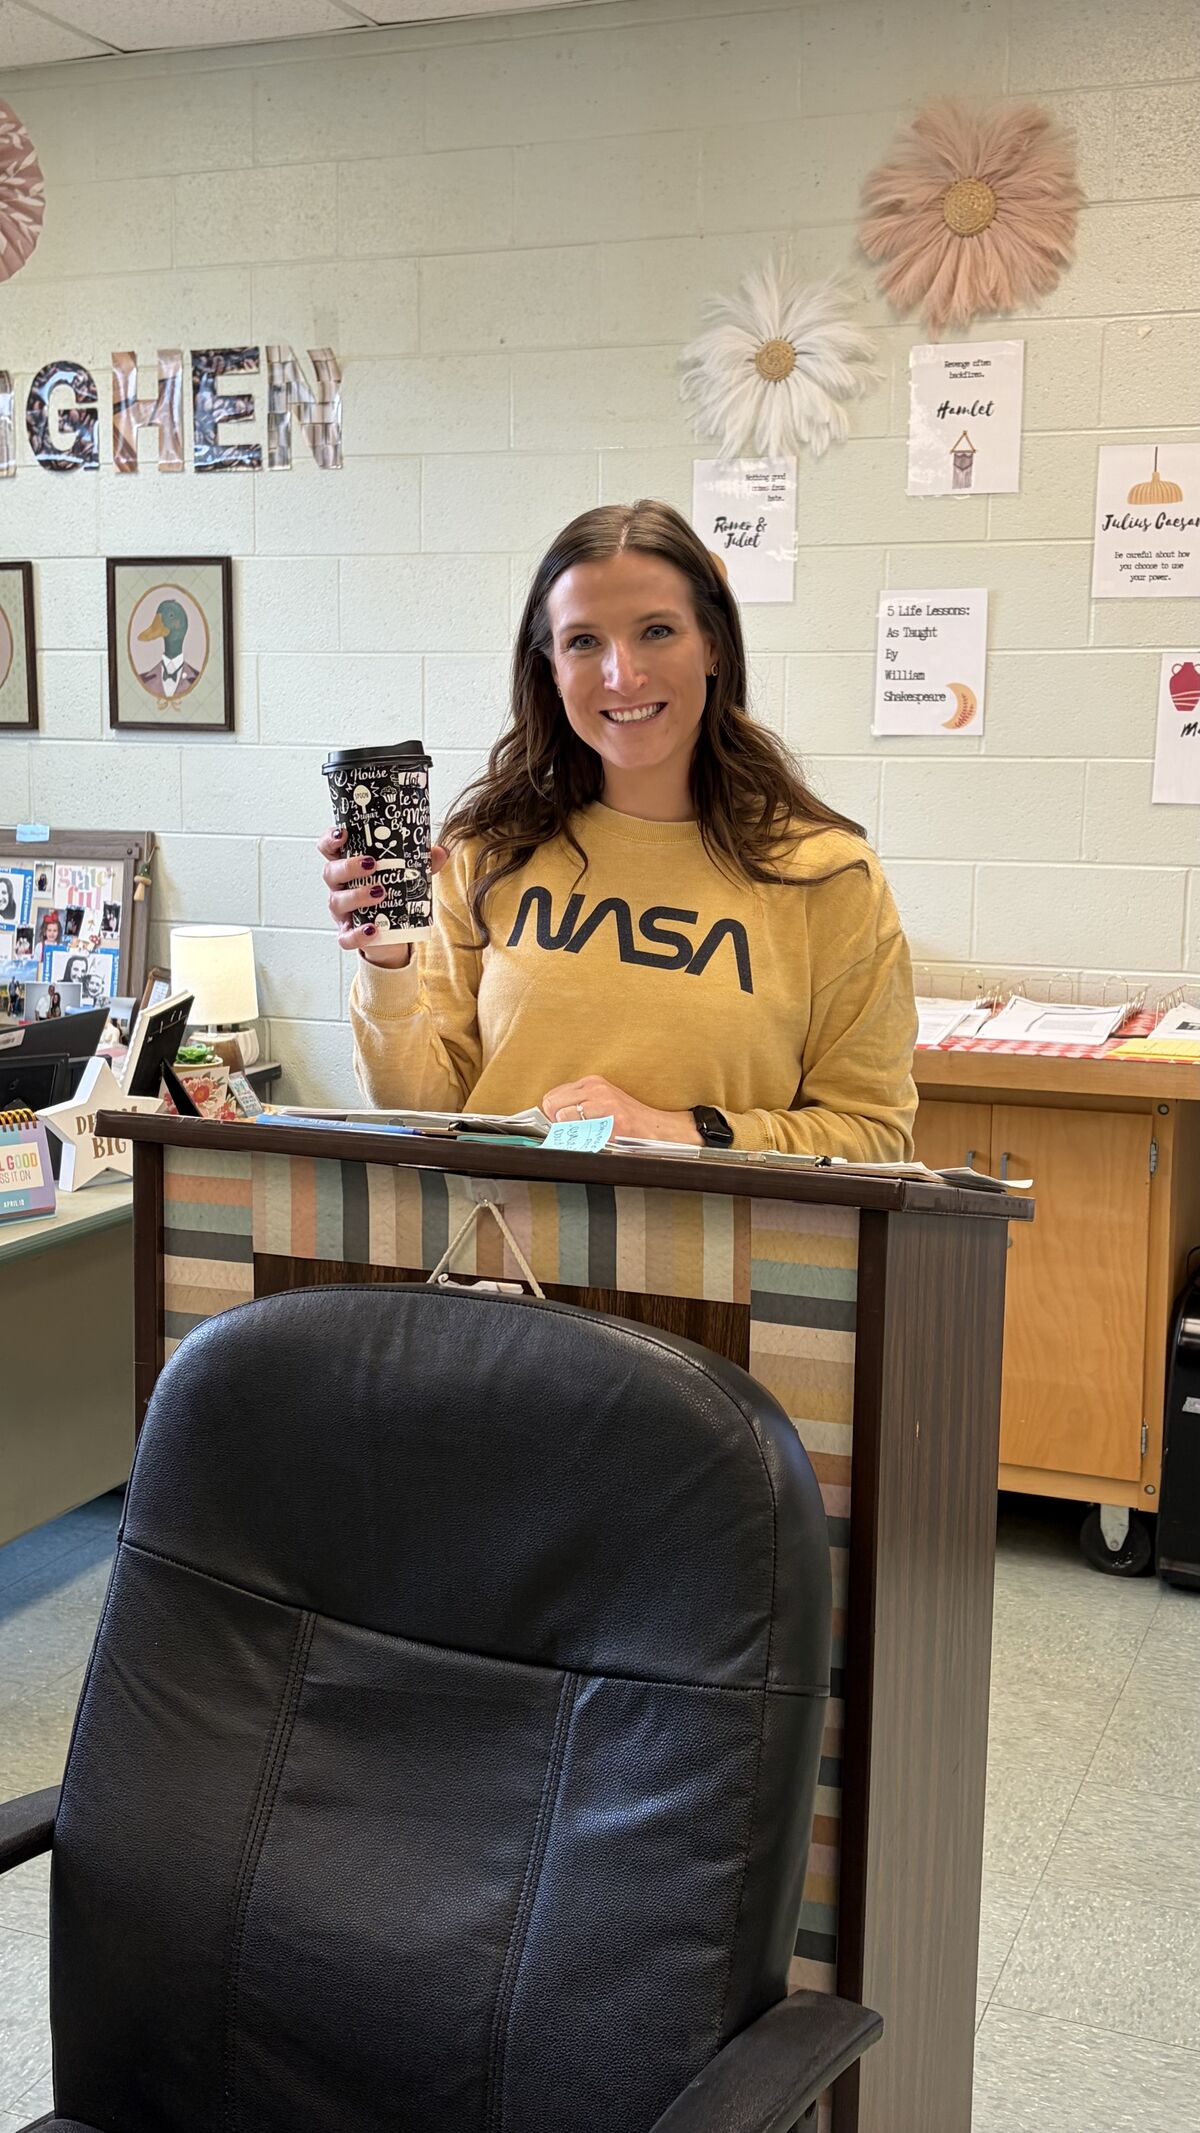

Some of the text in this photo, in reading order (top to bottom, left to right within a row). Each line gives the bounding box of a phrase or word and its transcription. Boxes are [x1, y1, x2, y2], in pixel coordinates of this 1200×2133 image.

[936, 400, 994, 419] Hamlet
[713, 516, 768, 533] Romeo &
[1102, 513, 1152, 532] Julius
[724, 532, 761, 548] Juliet
[1114, 551, 1124, 559] Be
[1126, 551, 1152, 559] careful
[1178, 550, 1191, 558] how
[1119, 564, 1132, 572] you
[1161, 562, 1169, 570] to
[1129, 574, 1172, 583] your power.
[887, 605, 971, 617] 5 Life Lessons:
[886, 626, 939, 641] As Taught
[885, 649, 899, 662] By
[884, 670, 926, 681] William
[883, 691, 947, 704] Shakespeare
[1180, 721, 1200, 738] M
[350, 768, 388, 782] House
[506, 886, 754, 994] NASA
[92, 1138, 127, 1159] BIG
[6, 1152, 38, 1170] GOOD
[11, 1171, 17, 1182] IT
